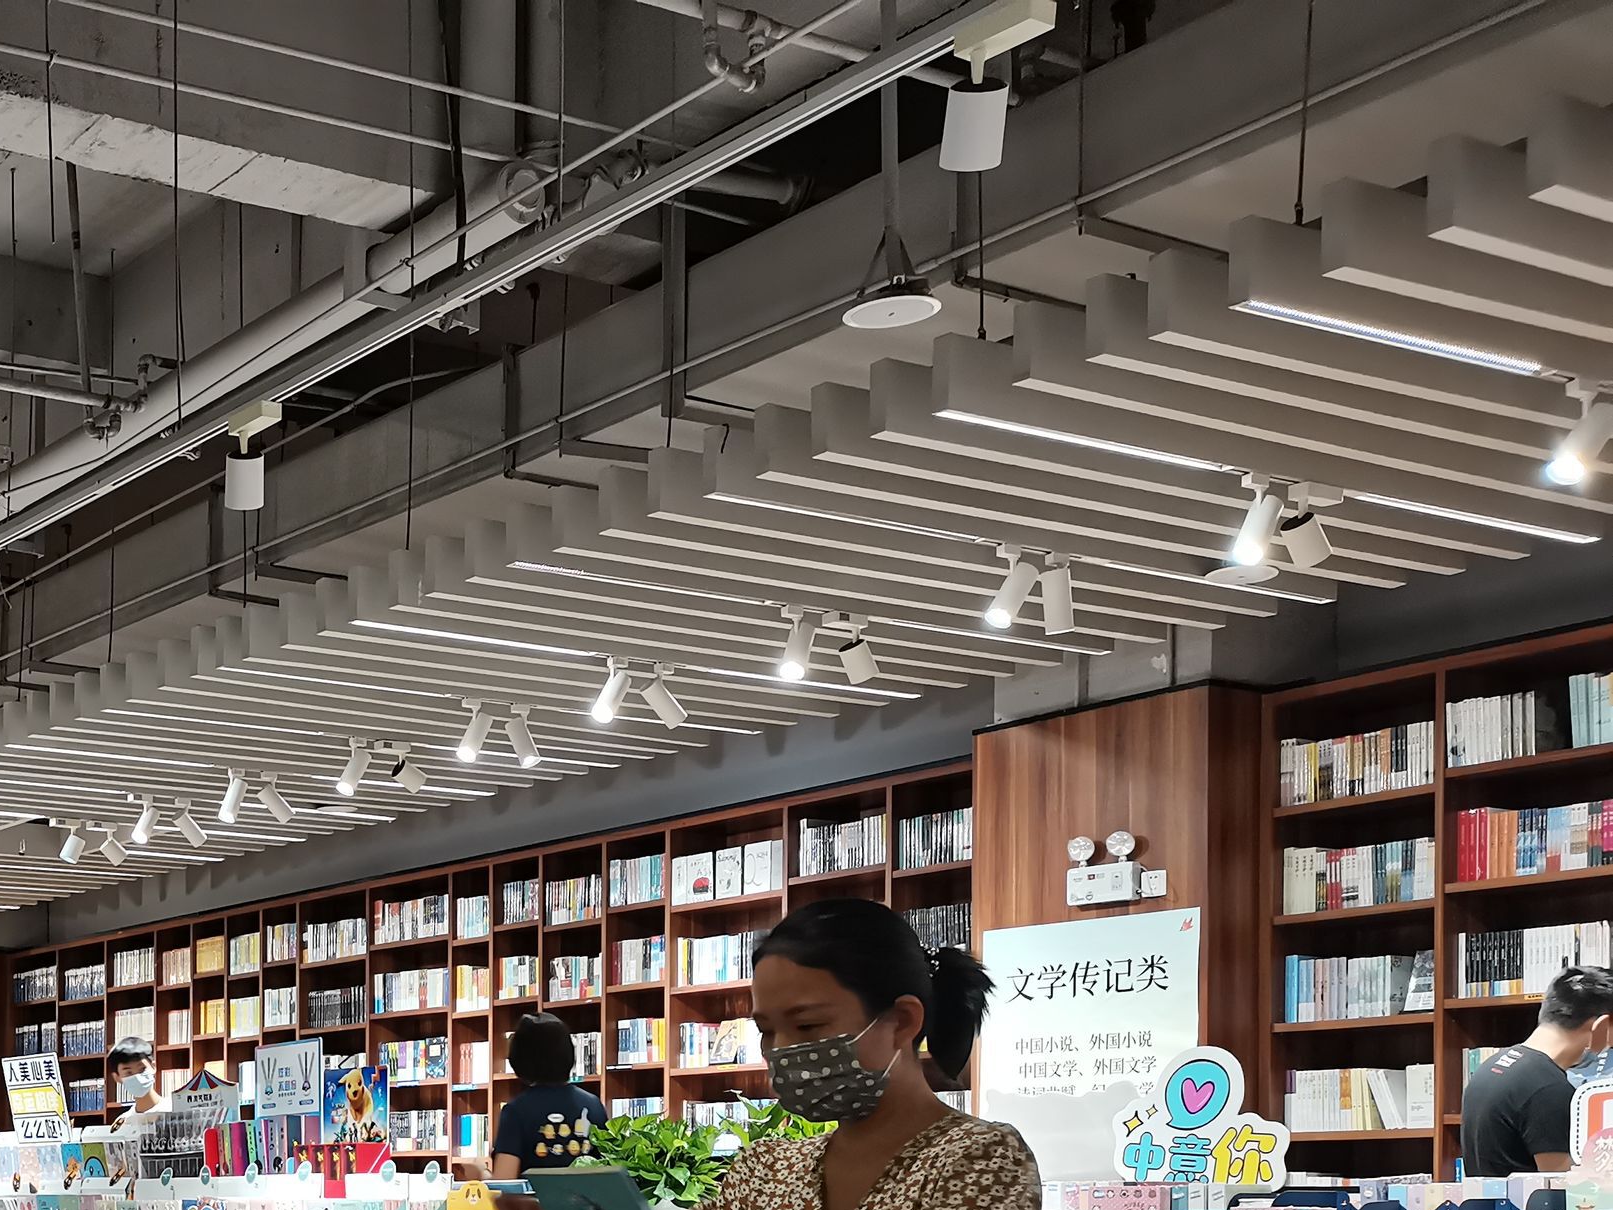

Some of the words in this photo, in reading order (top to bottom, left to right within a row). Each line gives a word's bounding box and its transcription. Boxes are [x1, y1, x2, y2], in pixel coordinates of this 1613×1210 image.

[1005, 954, 1170, 1003] 文学传记类
[1015, 1030, 1153, 1055] 中国小说、外国小说
[9, 1059, 56, 1082] 人美心美
[1018, 1055, 1158, 1080] 中国文学、外国文学
[1124, 1124, 1278, 1184] 中意你
